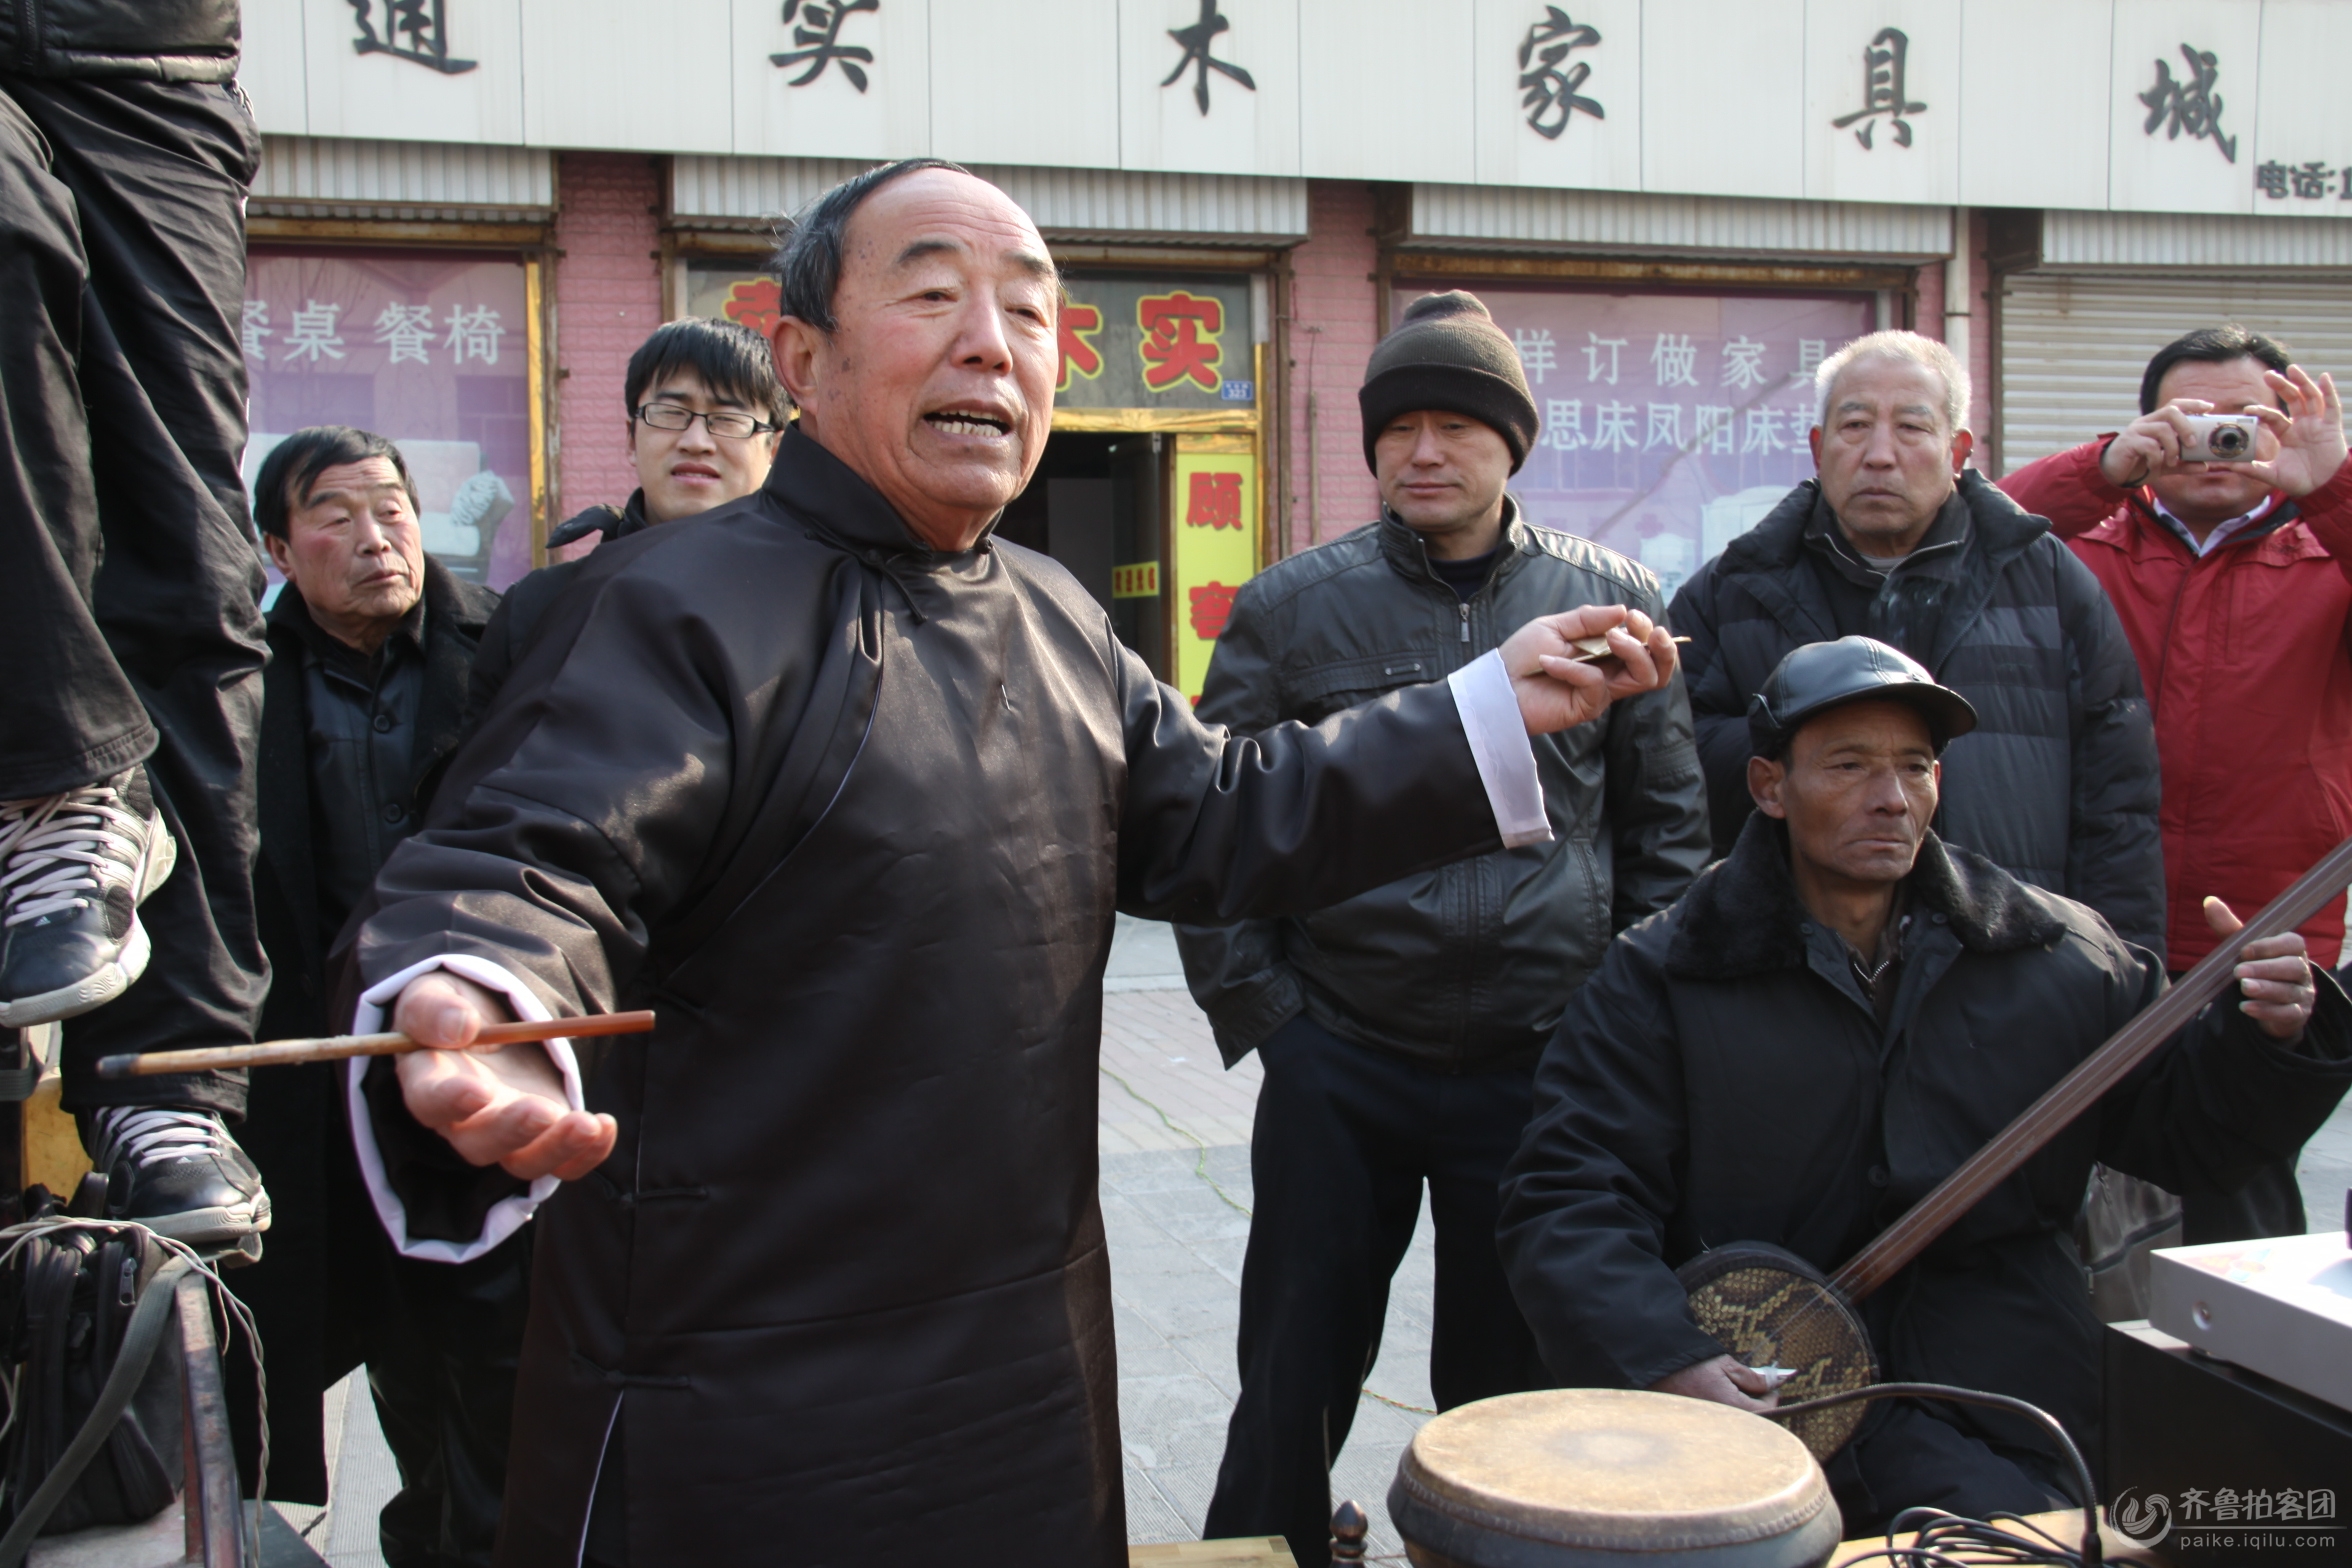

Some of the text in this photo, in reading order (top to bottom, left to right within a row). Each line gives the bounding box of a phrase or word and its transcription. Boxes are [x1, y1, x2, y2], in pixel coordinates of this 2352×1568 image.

[1513, 328, 1828, 390] 样订做家具
